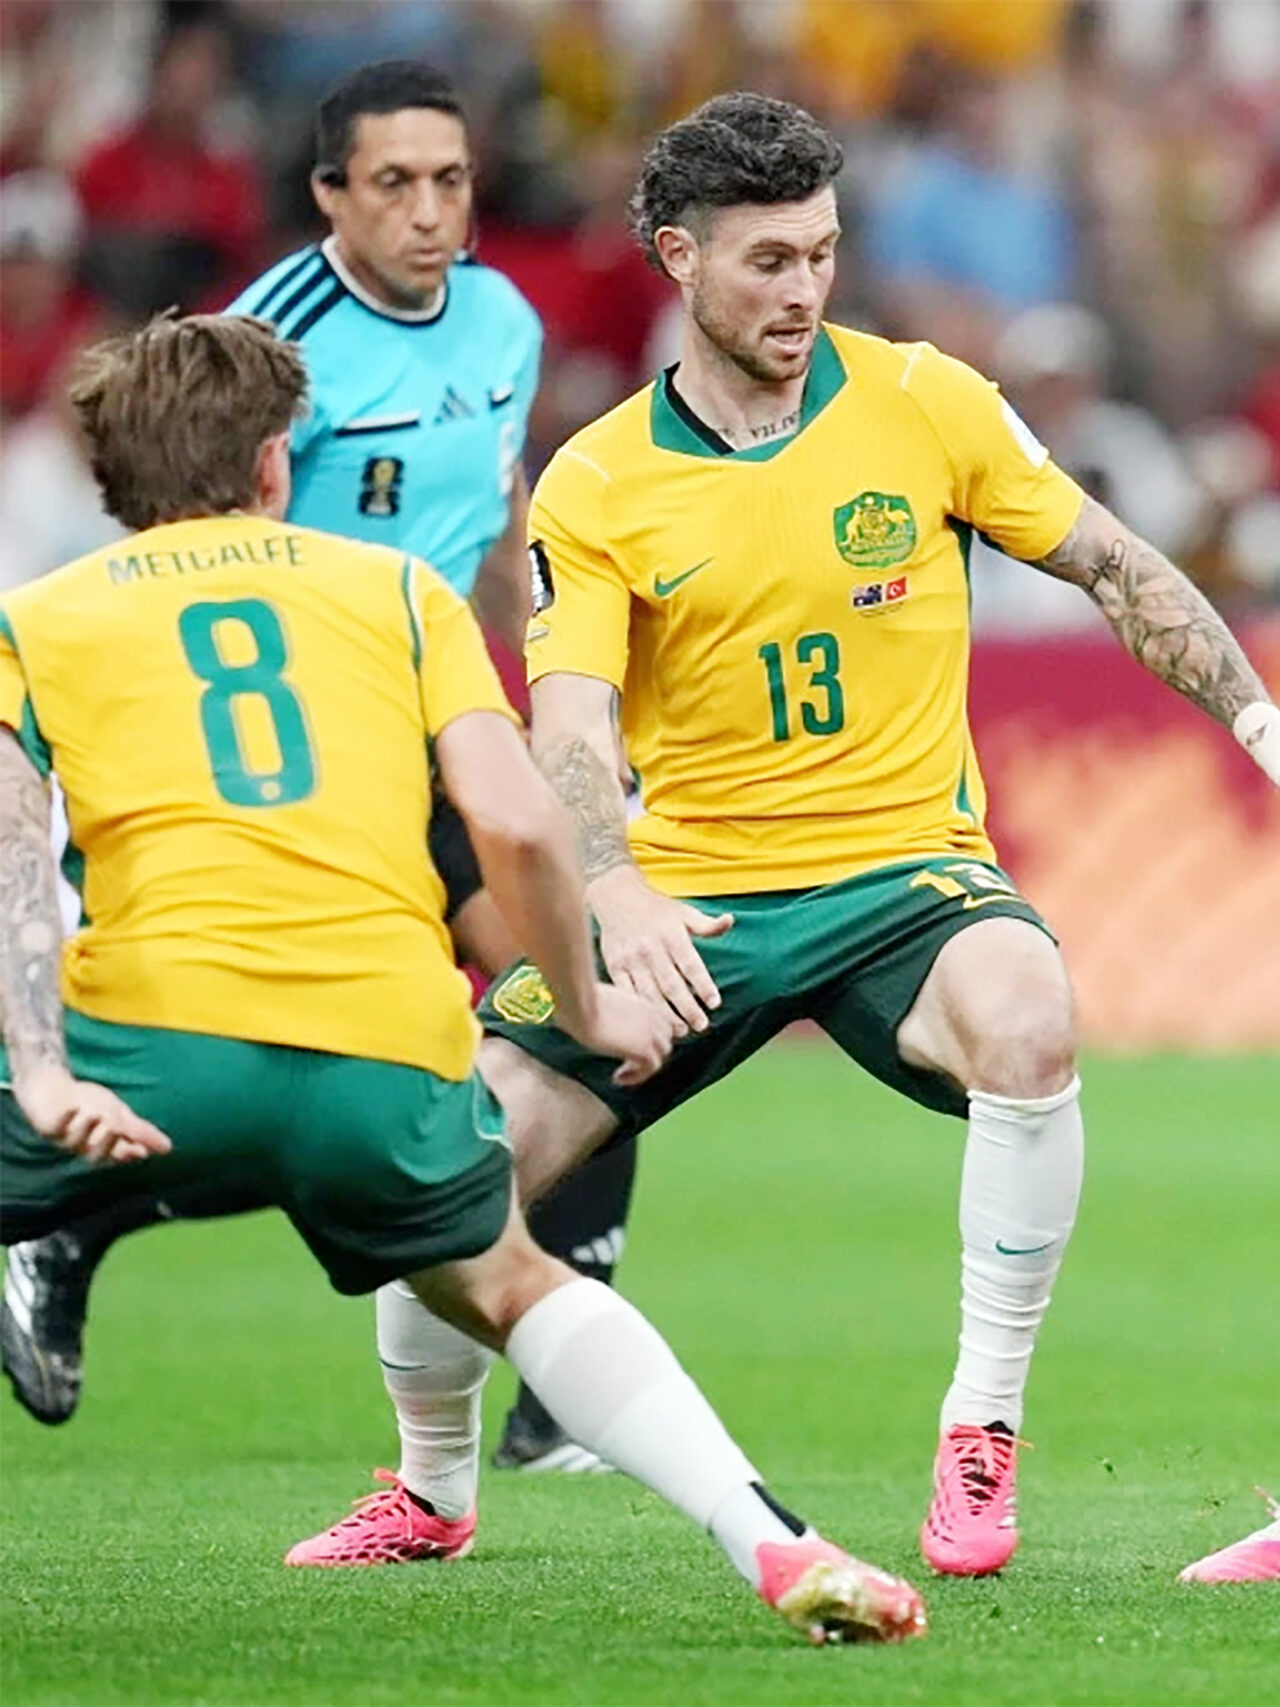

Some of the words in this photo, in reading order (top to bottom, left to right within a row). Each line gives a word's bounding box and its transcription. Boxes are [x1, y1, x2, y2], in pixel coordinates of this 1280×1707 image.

[107, 535, 308, 586] METCALFE
[178, 598, 317, 807] 8
[758, 631, 845, 743] 13
